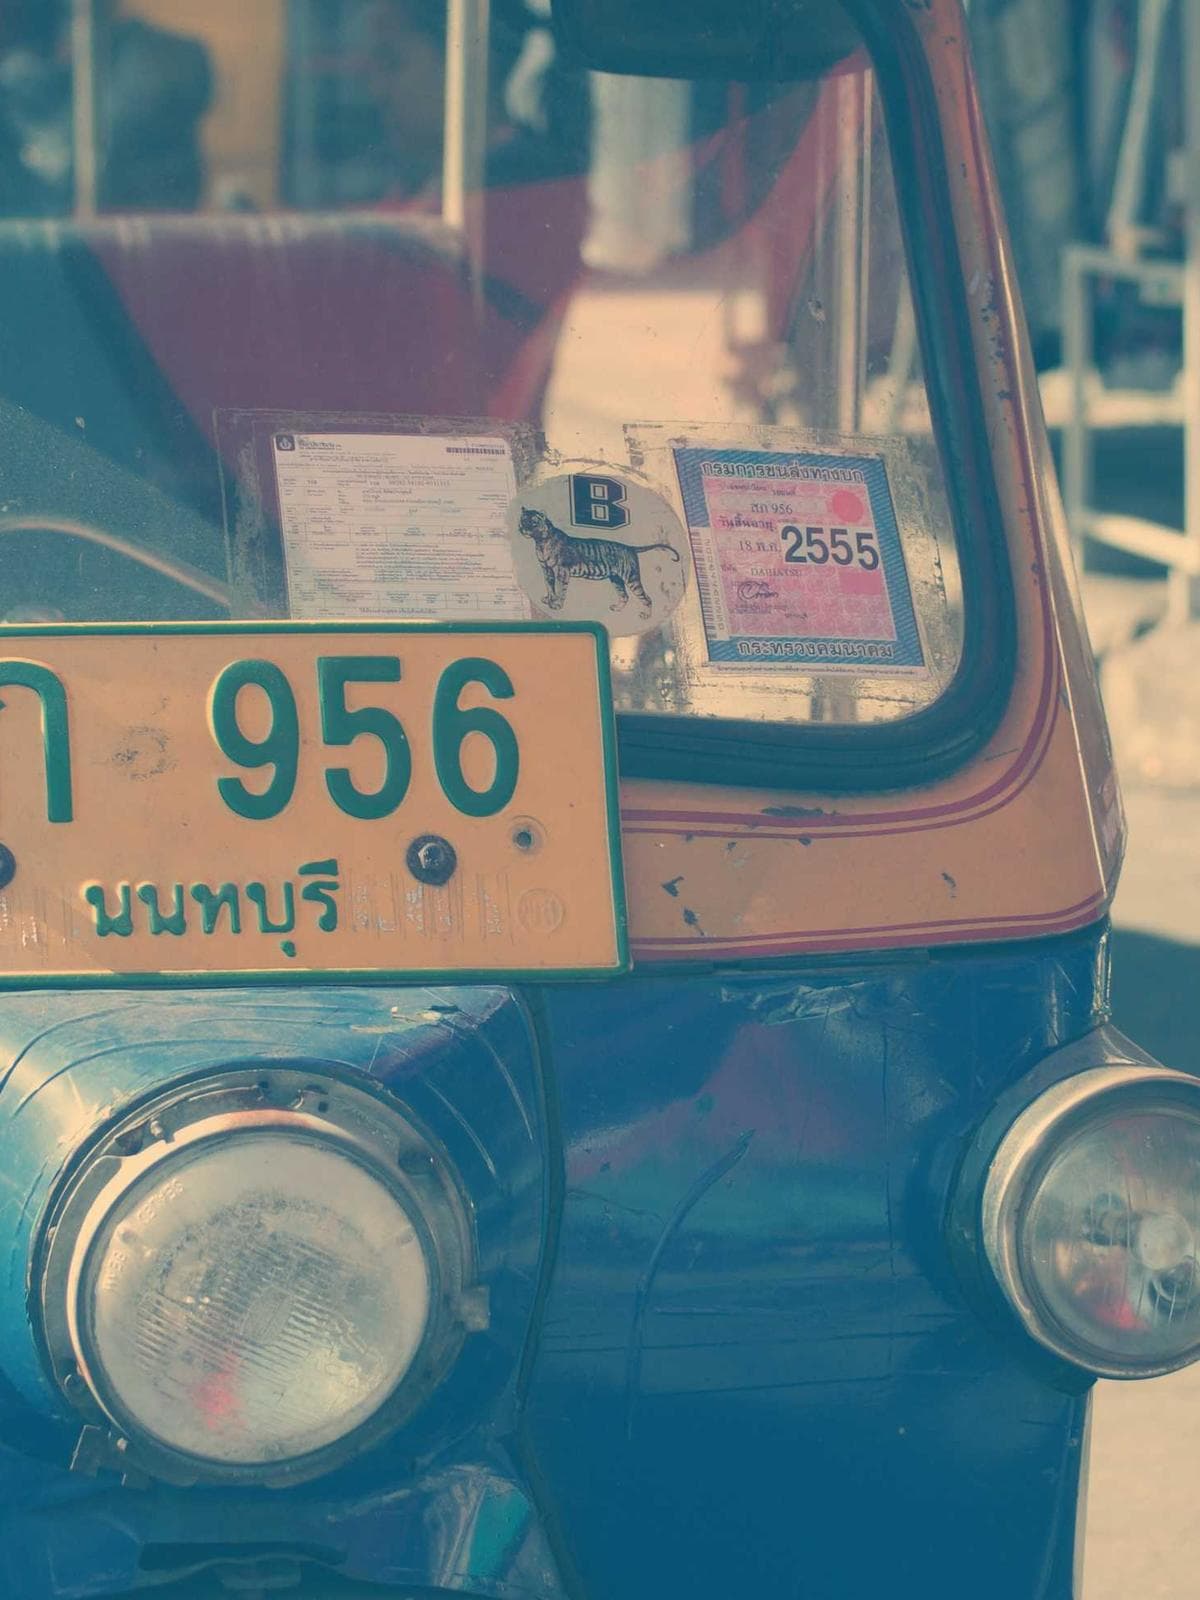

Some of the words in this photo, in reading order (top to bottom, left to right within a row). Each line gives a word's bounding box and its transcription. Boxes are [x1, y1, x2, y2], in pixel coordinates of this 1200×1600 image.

[702, 461, 864, 482] กรมการขนส่งทางบก
[569, 473, 630, 530] B
[771, 503, 794, 516] 956
[739, 541, 753, 552] 18
[781, 525, 879, 570] 2555
[738, 641, 894, 658] กระทรวงคมนาคม
[211, 656, 520, 820] 956
[83, 858, 340, 958] นนทบุรี
